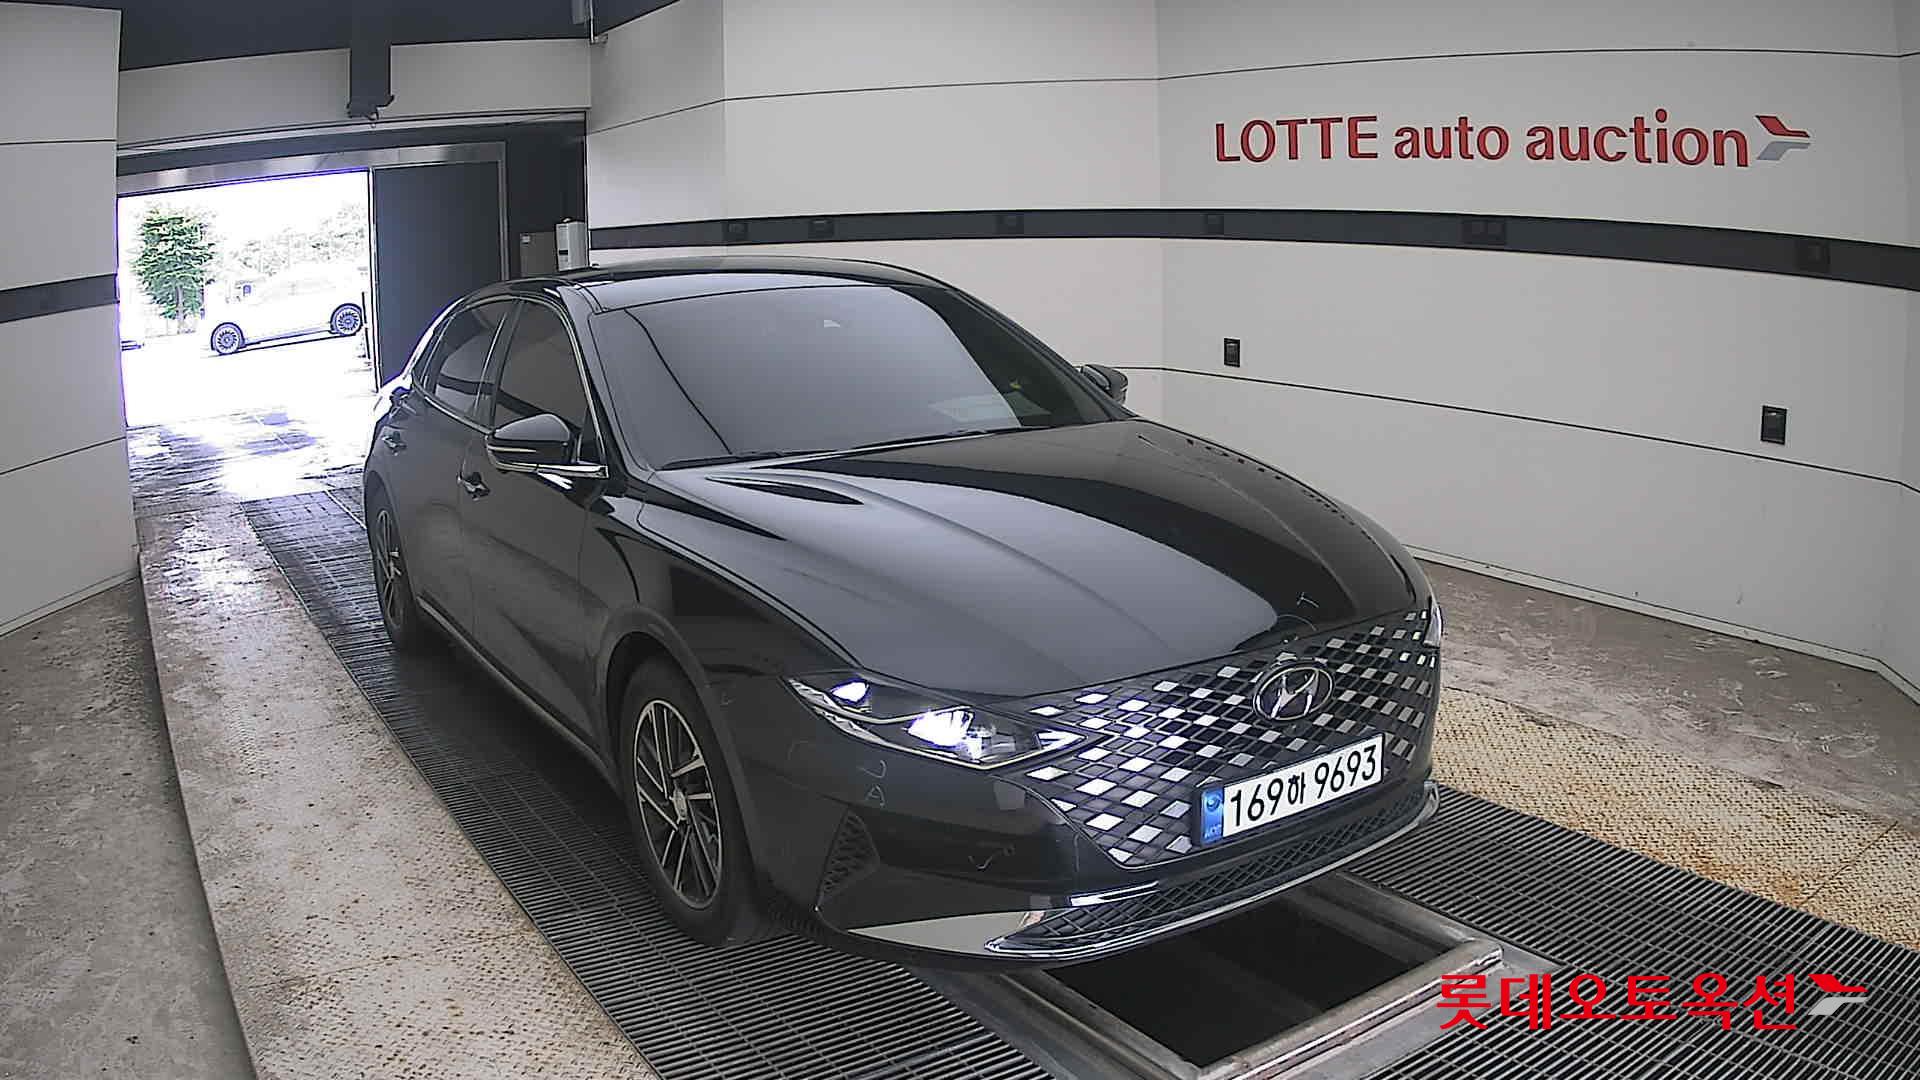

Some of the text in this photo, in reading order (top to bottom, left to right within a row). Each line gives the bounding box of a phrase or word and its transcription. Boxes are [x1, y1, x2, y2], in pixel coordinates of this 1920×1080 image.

[1215, 107, 1748, 167] LOTTE auto auction
[1230, 745, 1377, 827] 169하 9693
